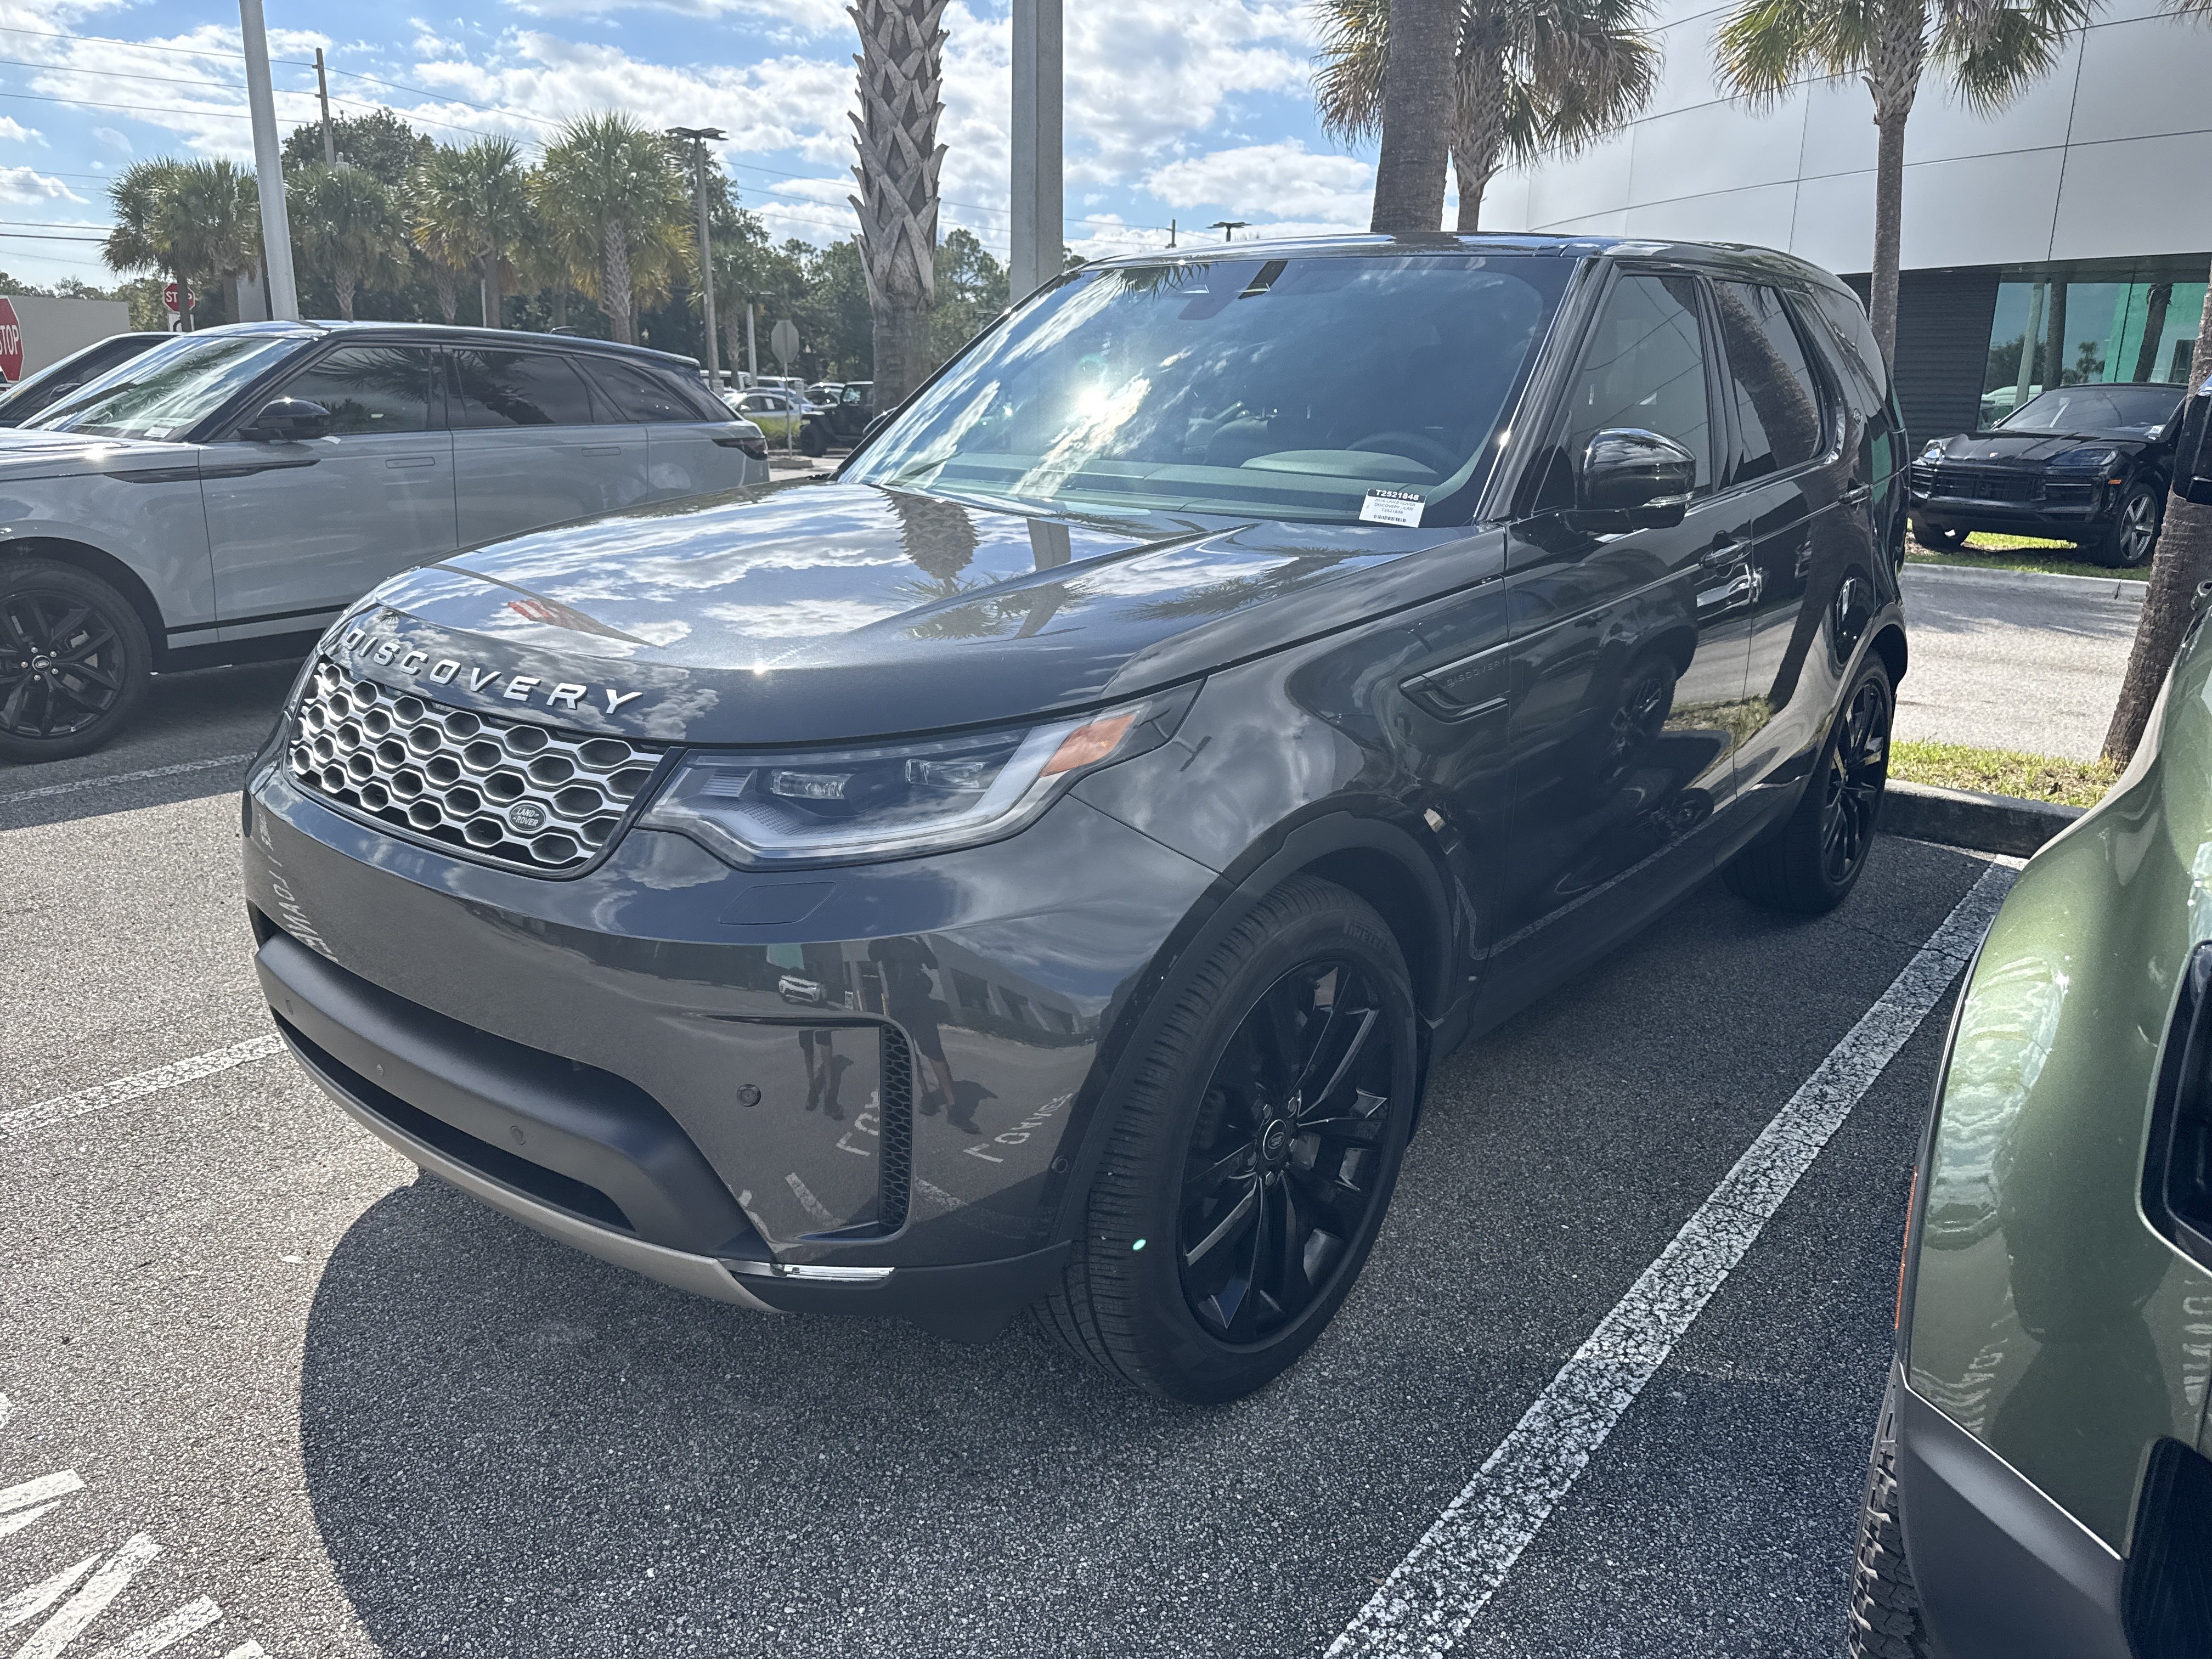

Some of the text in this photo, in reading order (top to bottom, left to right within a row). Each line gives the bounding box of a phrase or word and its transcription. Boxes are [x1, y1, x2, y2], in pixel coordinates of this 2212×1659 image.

[166, 291, 193, 303] STP
[1375, 489, 1419, 501] T2521848
[342, 628, 644, 714] DISCOVERY
[1446, 657, 1507, 687] DISCOVERY
[516, 808, 535, 817] LAND
[515, 815, 539, 827] ROVER
